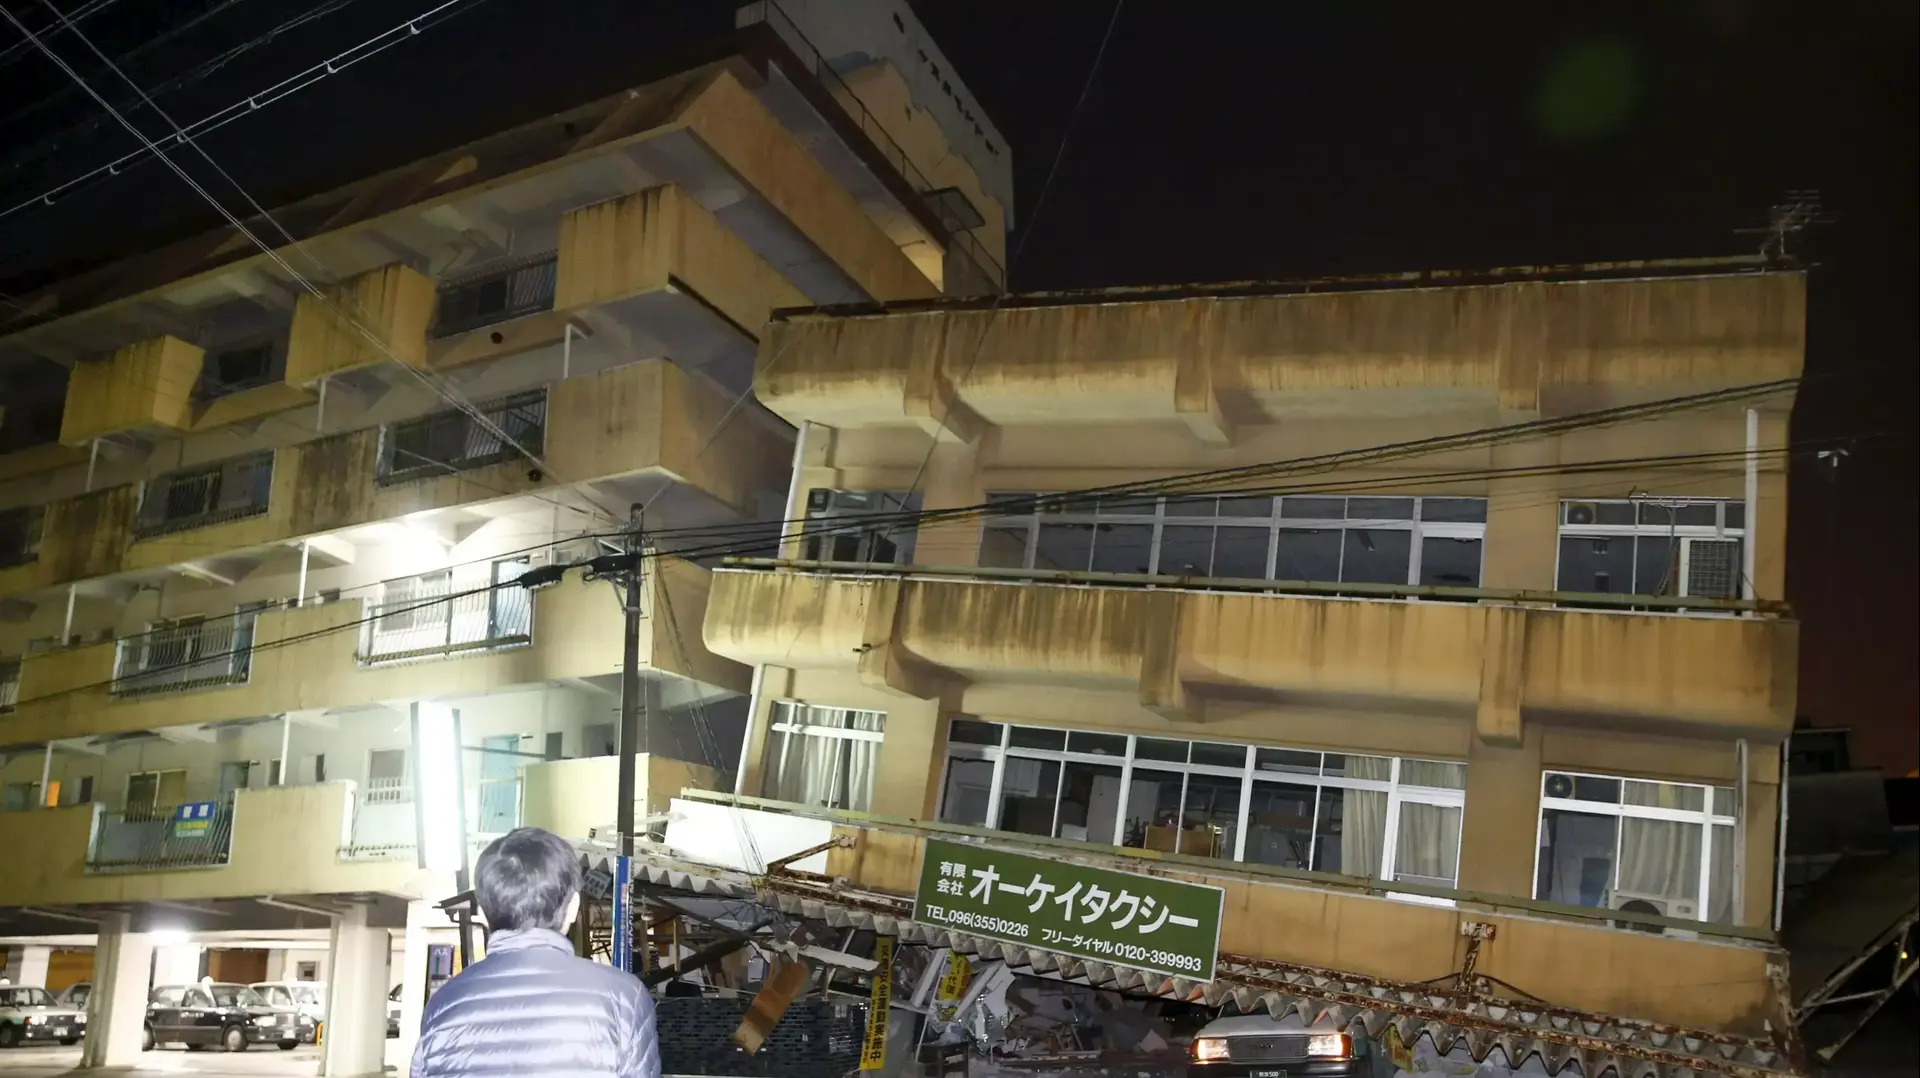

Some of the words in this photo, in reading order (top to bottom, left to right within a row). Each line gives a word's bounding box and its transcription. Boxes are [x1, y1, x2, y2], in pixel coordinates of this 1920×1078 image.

[940, 861, 967, 879] 有限
[936, 878, 964, 896] 会社
[969, 864, 1199, 934] オーケイタクシー
[1041, 928, 1113, 954] フリーダイヤル
[1114, 942, 1202, 972] 0120-399993
